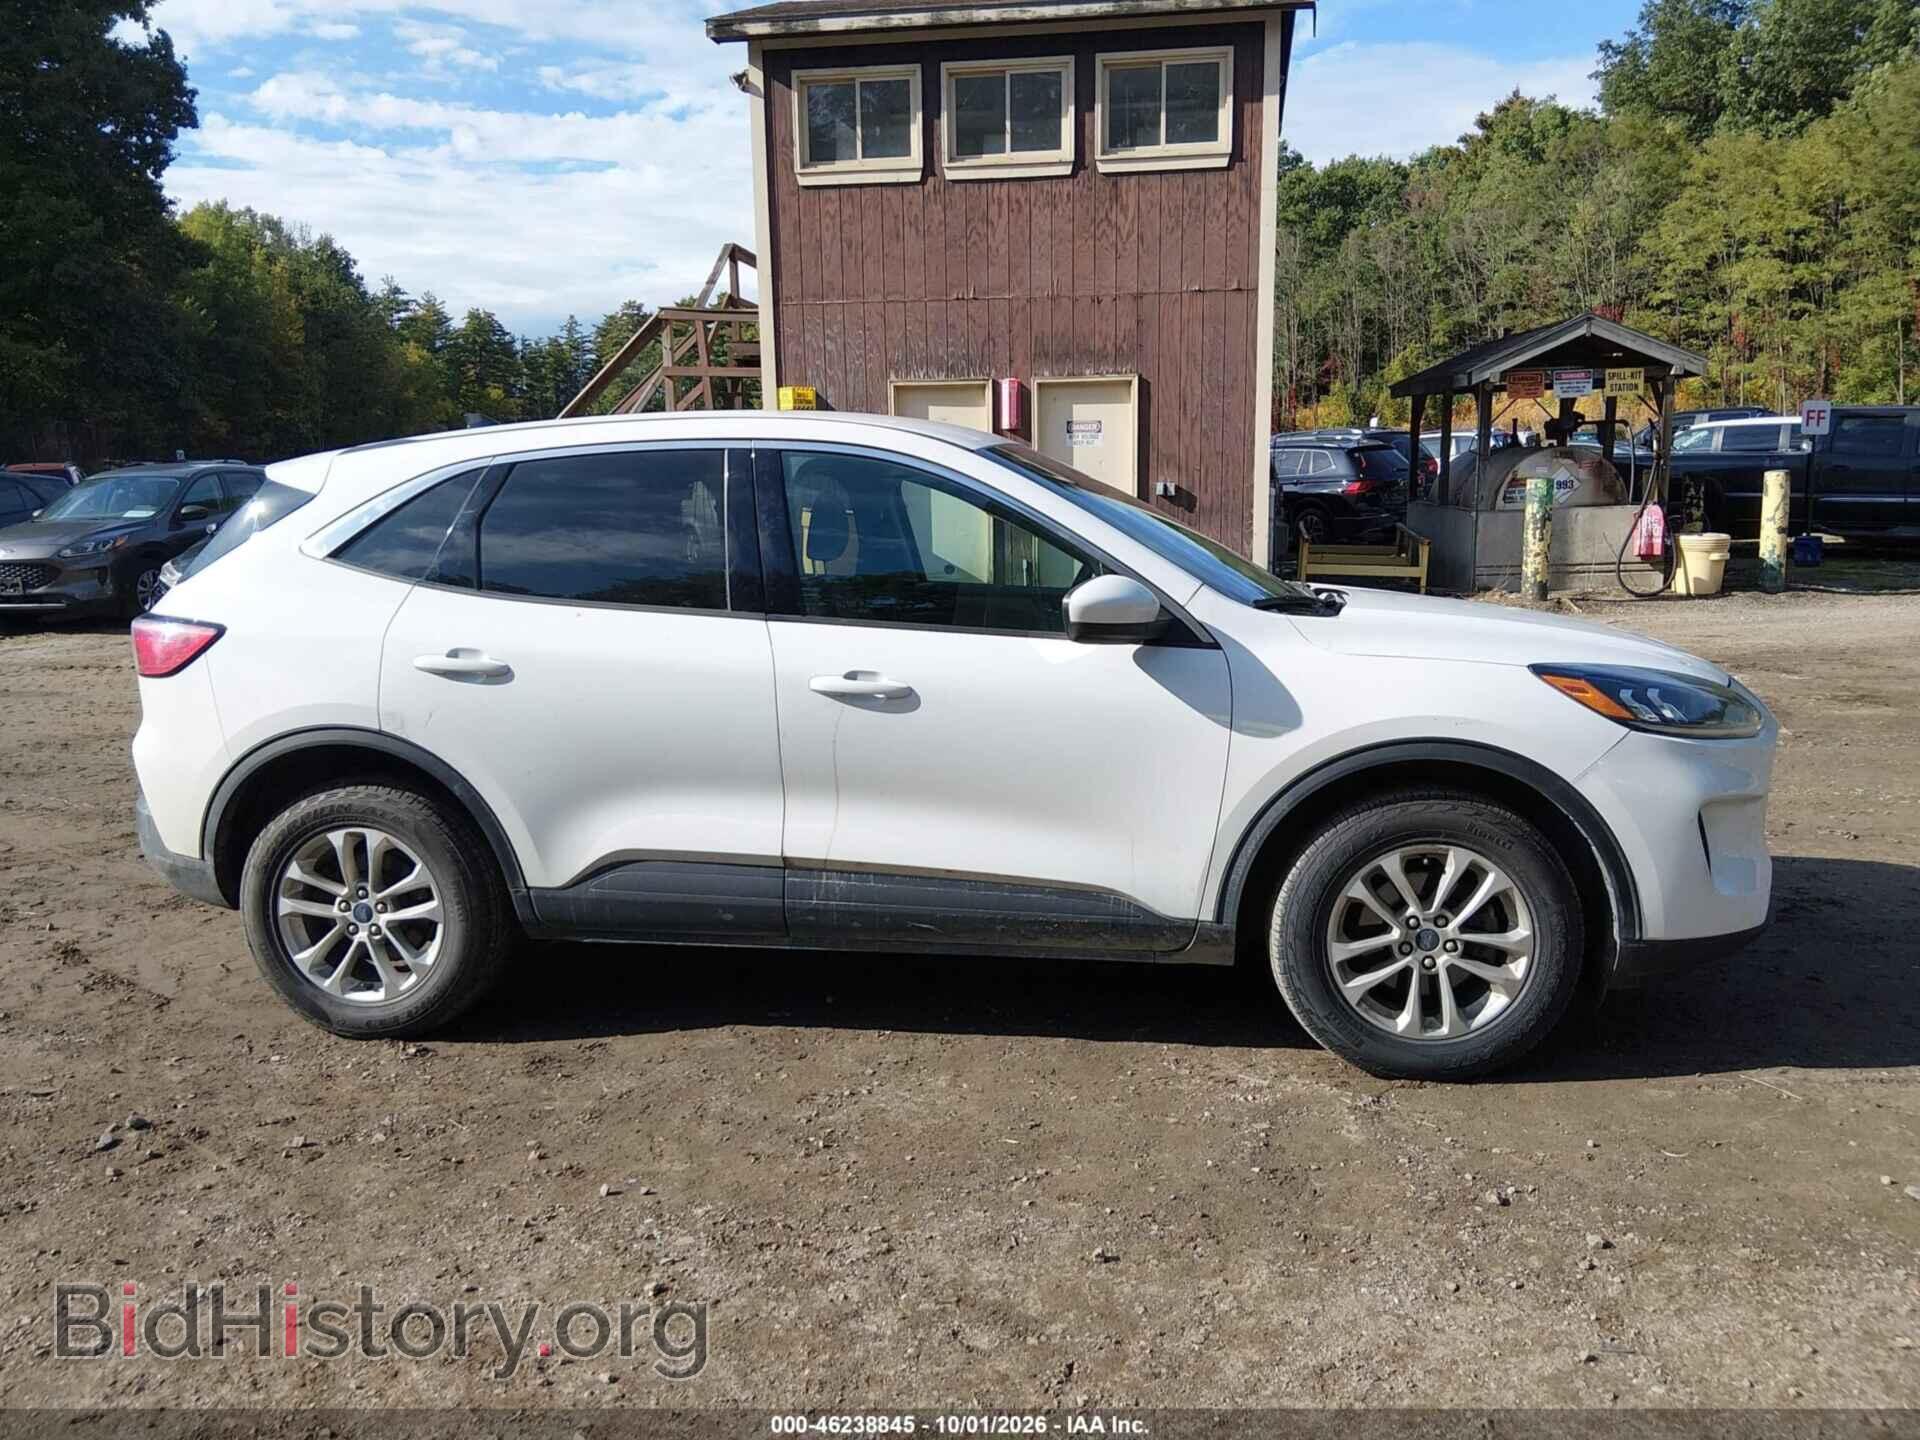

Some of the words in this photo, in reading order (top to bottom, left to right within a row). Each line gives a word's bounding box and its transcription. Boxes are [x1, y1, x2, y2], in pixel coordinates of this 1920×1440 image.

[1607, 371, 1642, 381] SPILL-KIT
[1609, 383, 1639, 392] STATION
[1806, 410, 1826, 427] FF
